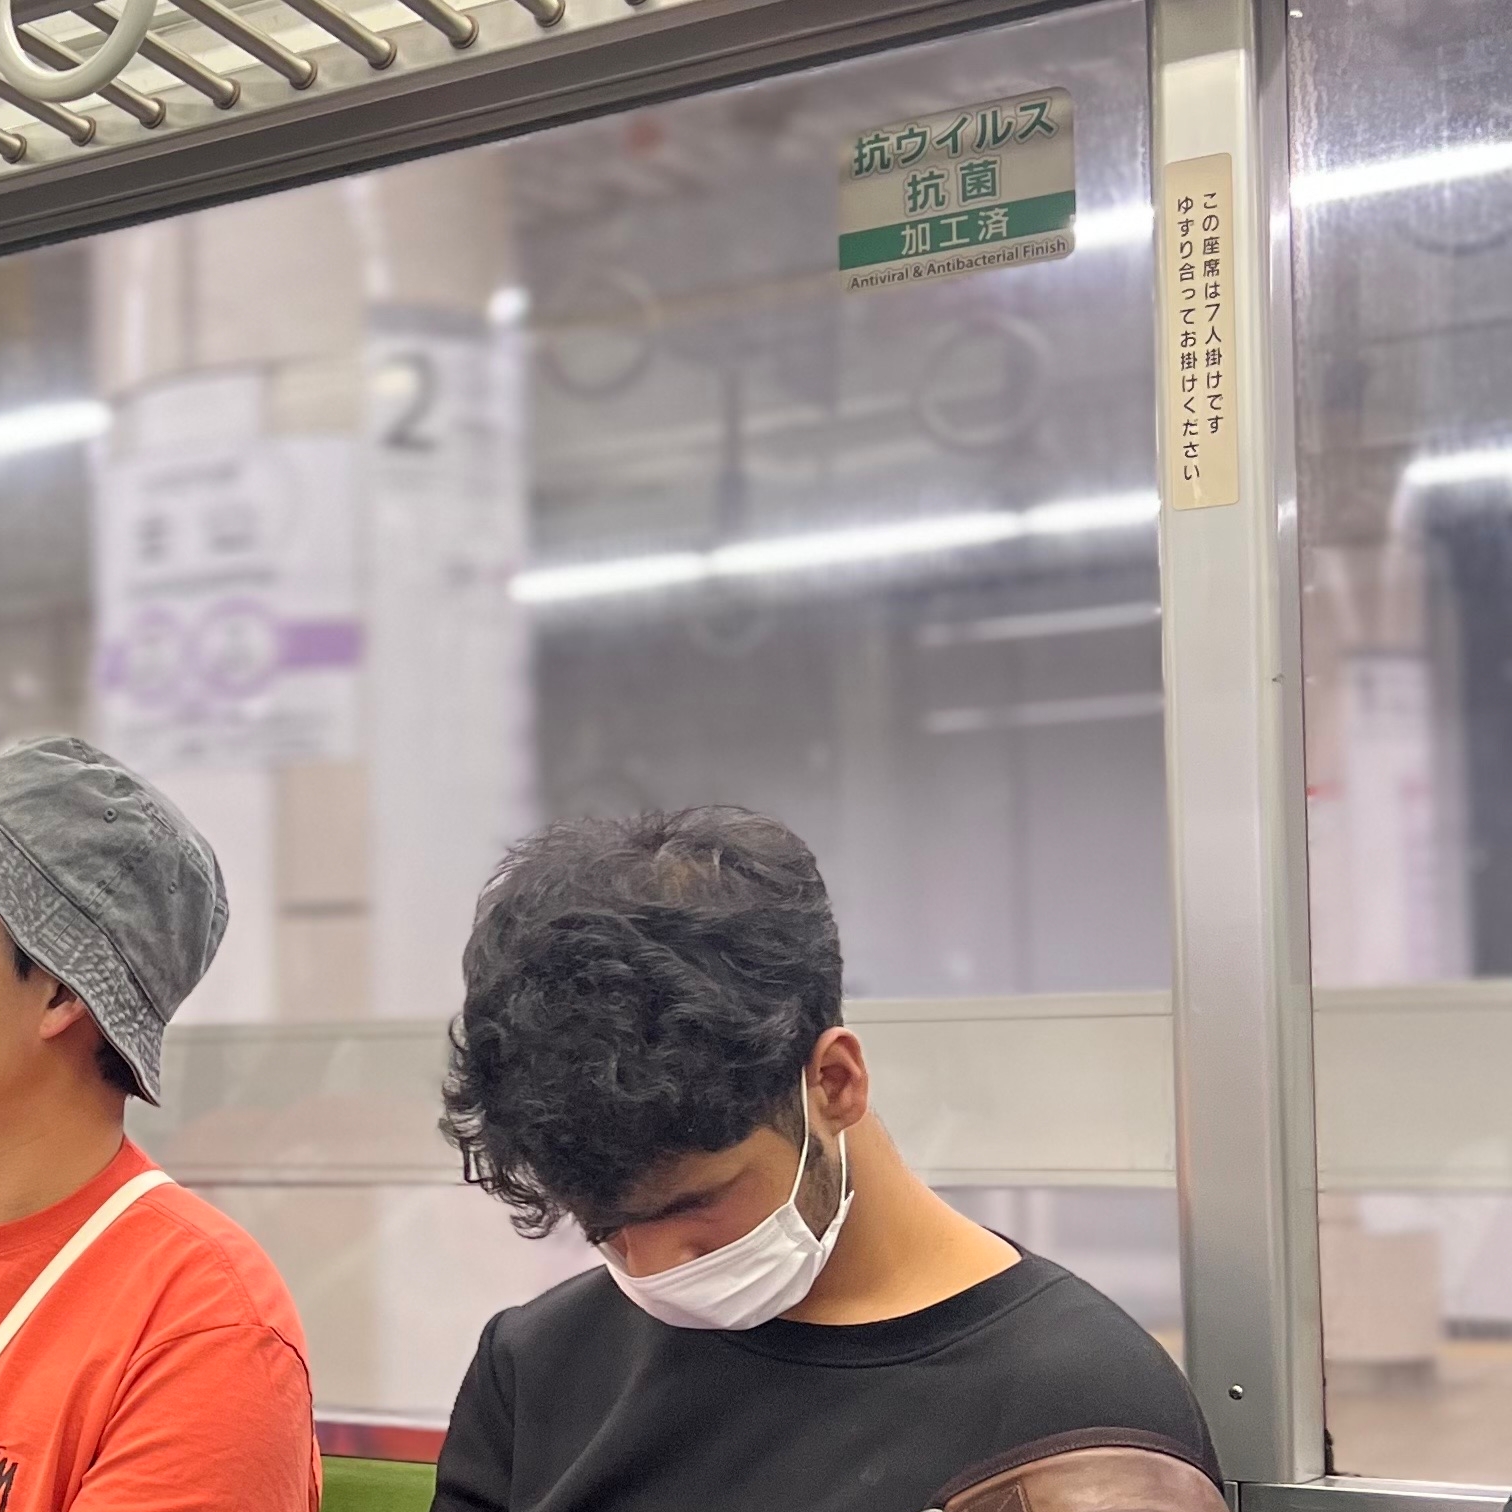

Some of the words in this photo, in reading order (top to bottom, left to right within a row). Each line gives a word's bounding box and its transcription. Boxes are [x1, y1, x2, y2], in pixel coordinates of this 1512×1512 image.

[852, 100, 1057, 177] 抗ウイルス
[906, 158, 1000, 214] 抗菌
[850, 268, 909, 290] Antiviral
[912, 265, 923, 278] &
[926, 250, 1019, 276] Antibacterial
[1023, 238, 1067, 258] Finish
[900, 207, 1009, 255] 加工済
[1176, 196, 1201, 482] ゆずり合ってお掛けください
[1202, 192, 1224, 435] この座席は7人掛けです
